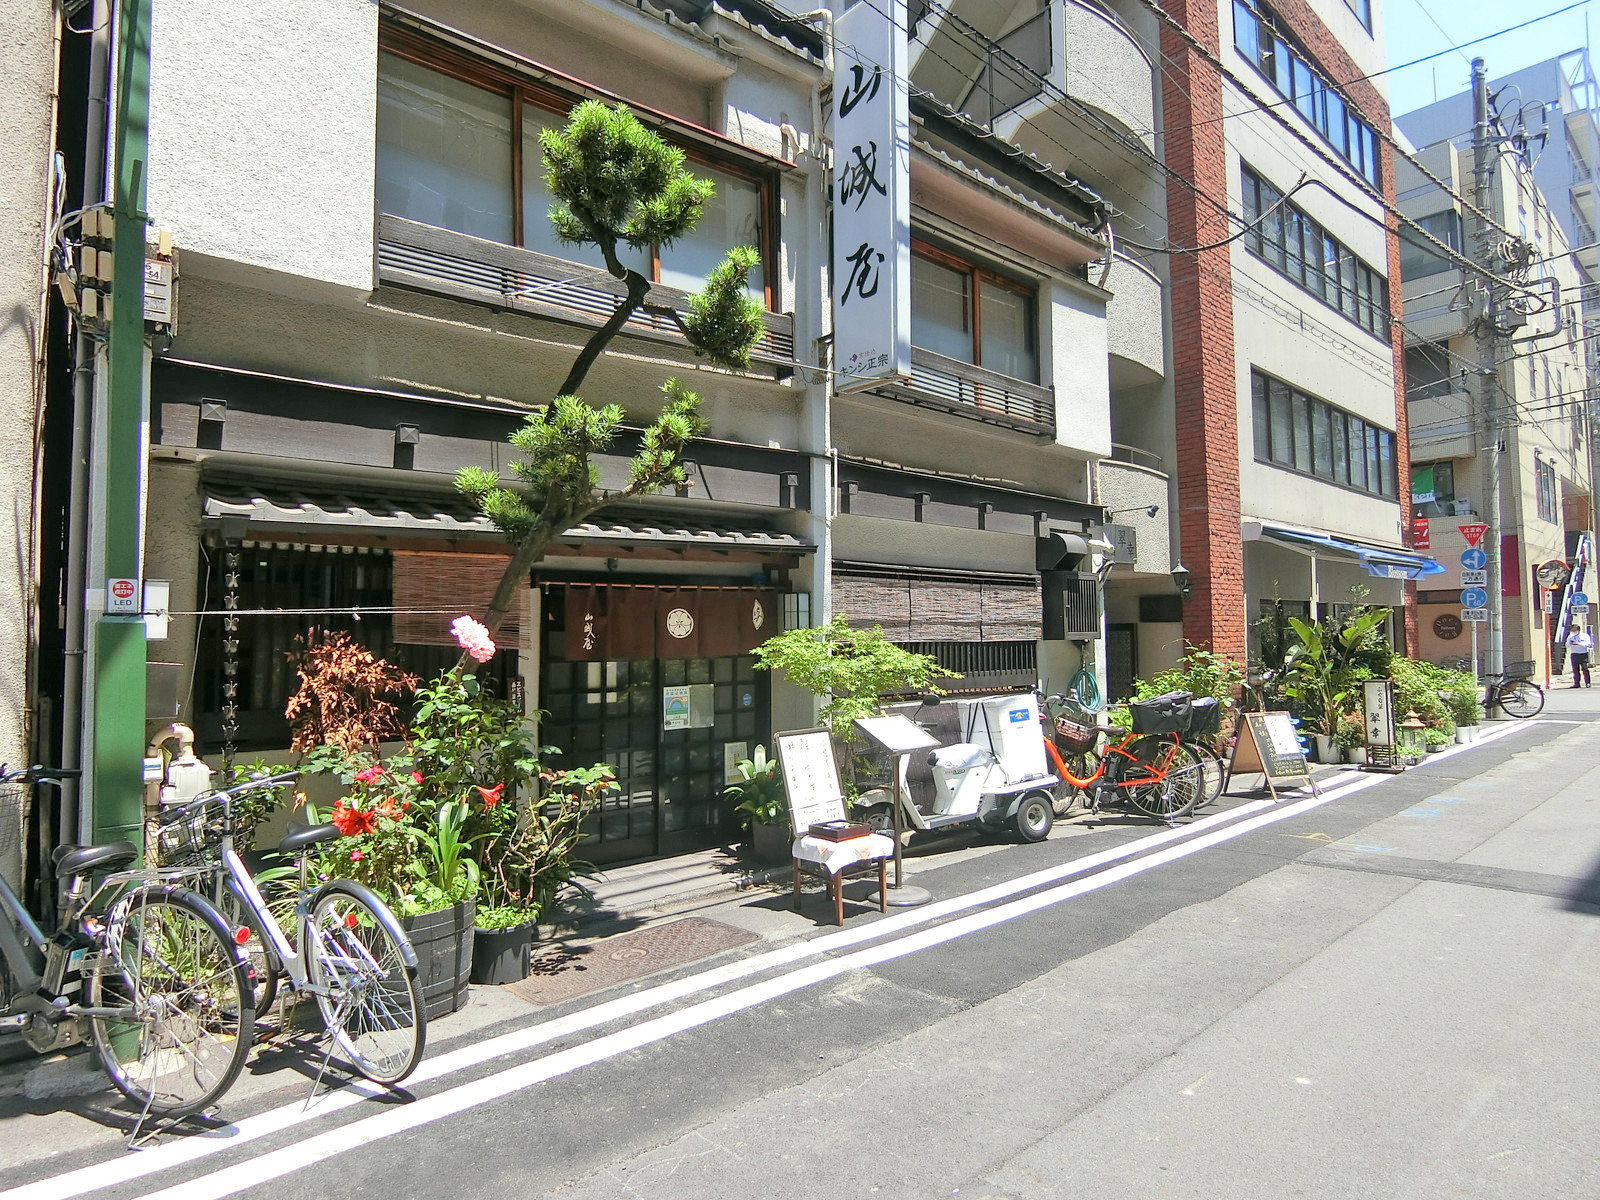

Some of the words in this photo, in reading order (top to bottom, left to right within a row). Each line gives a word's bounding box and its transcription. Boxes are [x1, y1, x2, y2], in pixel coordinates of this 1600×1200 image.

[838, 64, 887, 306] 山城屋
[840, 353, 888, 378] キンシ正宗
[1466, 593, 1477, 606] P
[1370, 712, 1381, 739] 翠幸
